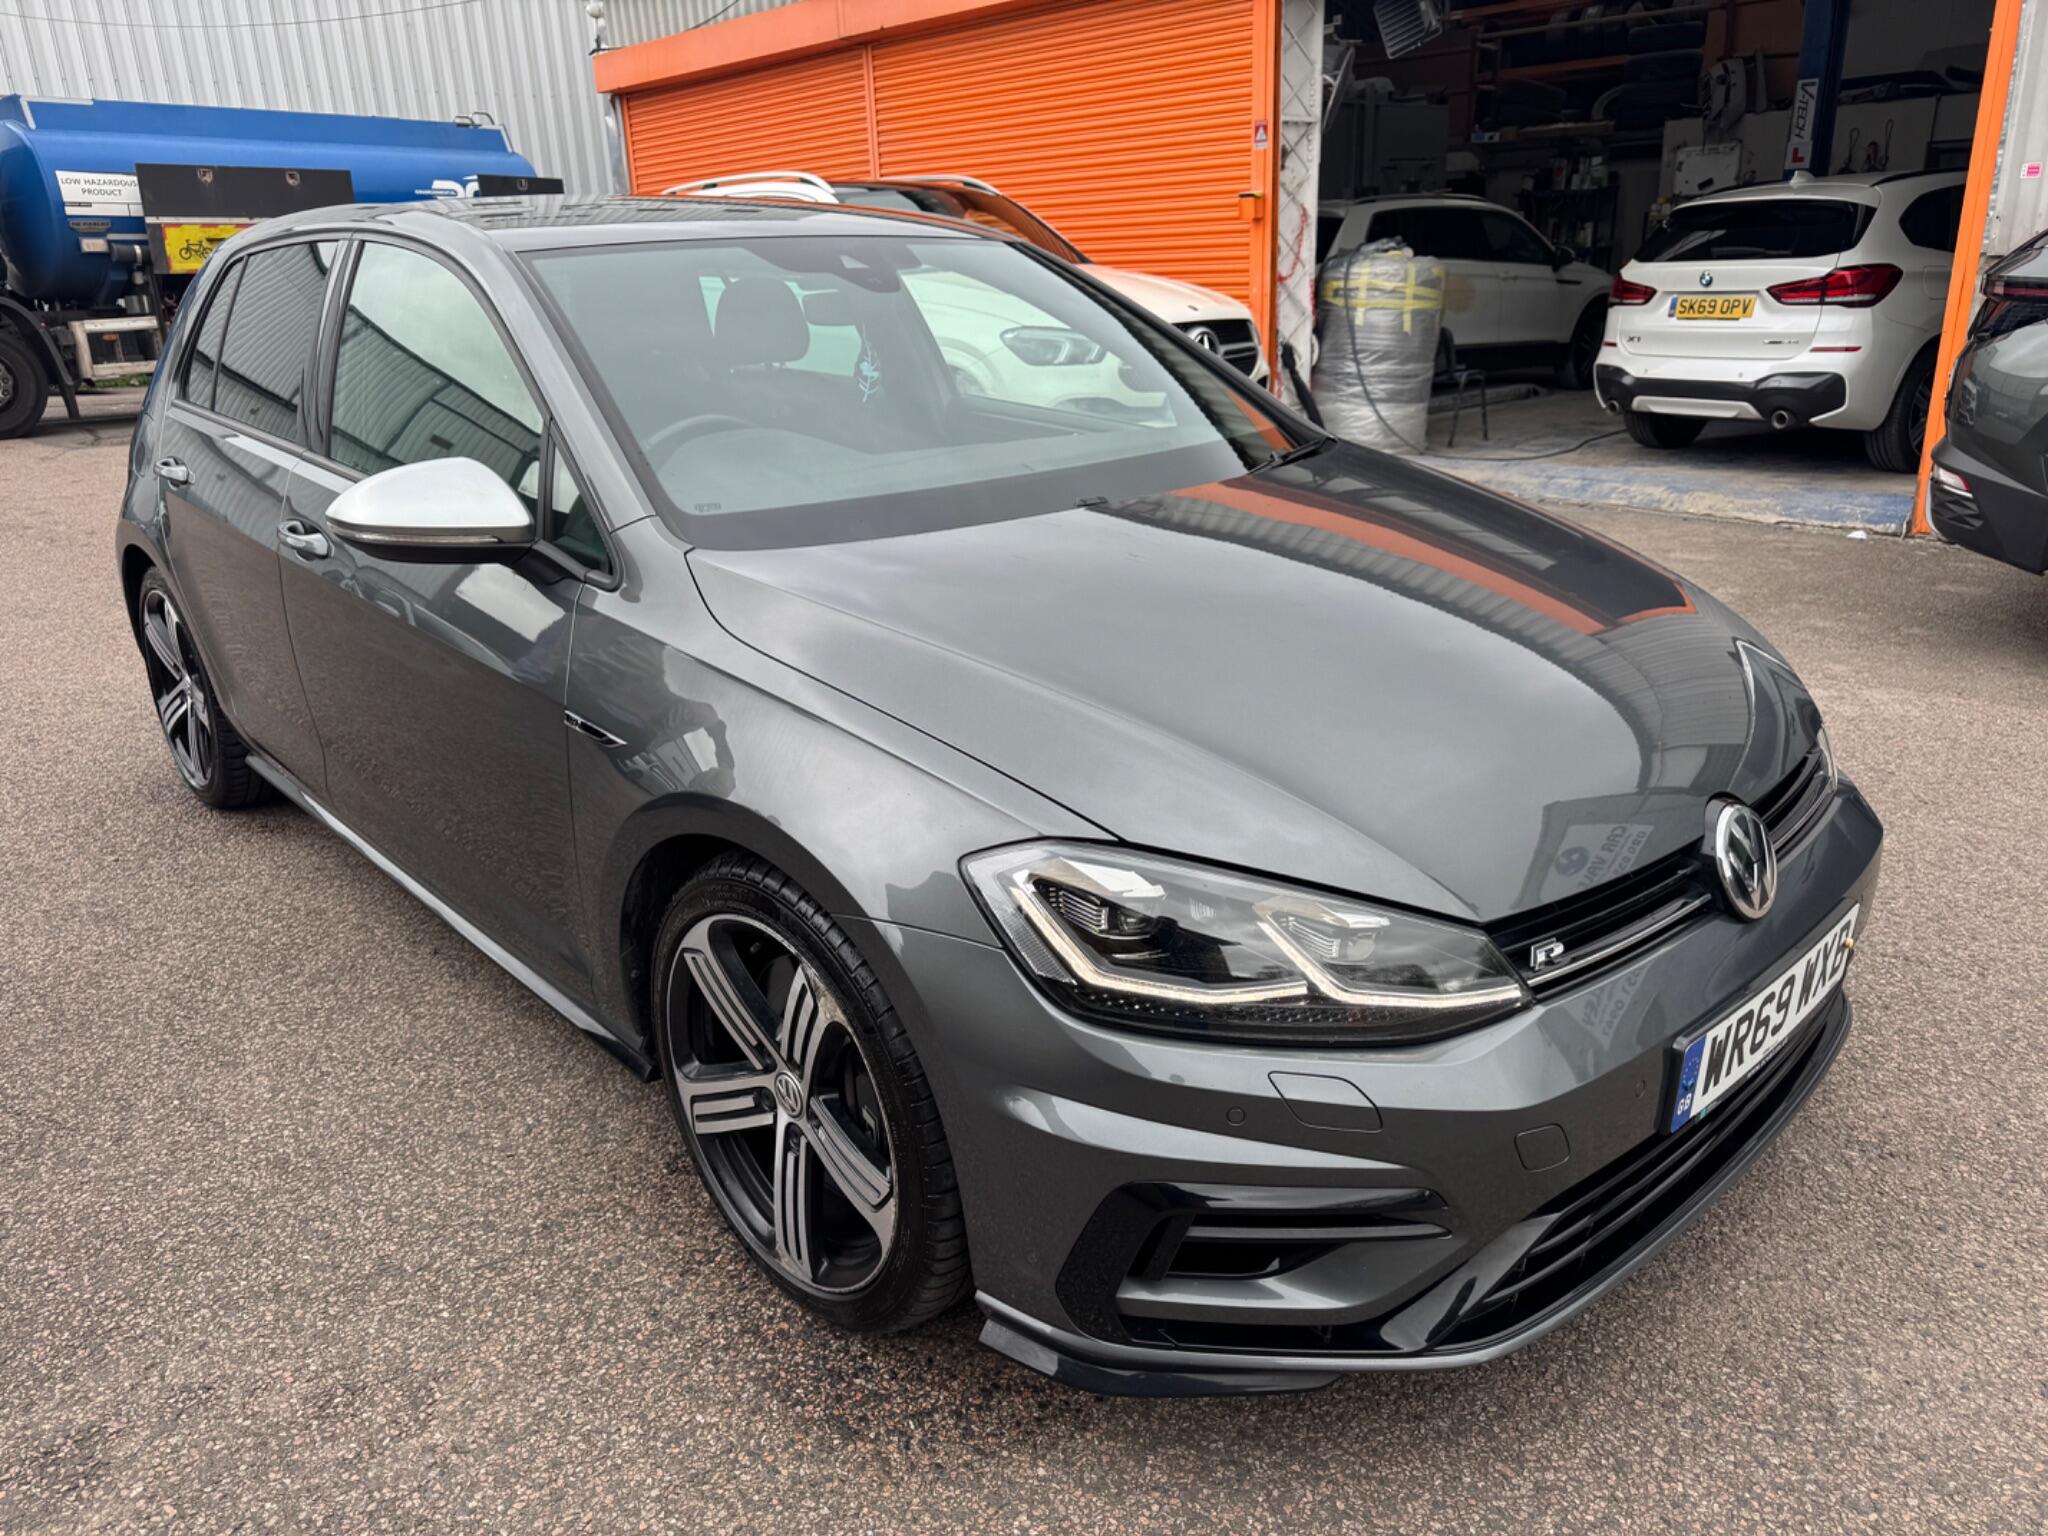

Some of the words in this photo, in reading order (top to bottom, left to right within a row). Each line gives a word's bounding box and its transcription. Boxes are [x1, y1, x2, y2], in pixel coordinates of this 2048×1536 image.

[1794, 81, 1817, 139] V-TECH
[81, 188, 123, 196] PRODUCT
[84, 178, 137, 187] HAZARDOUS
[1678, 298, 1717, 315] SK69
[1720, 298, 1753, 315] OPV
[1530, 937, 1567, 971] R
[1702, 973, 1797, 1098] WR69
[1676, 1092, 1693, 1116] GB
